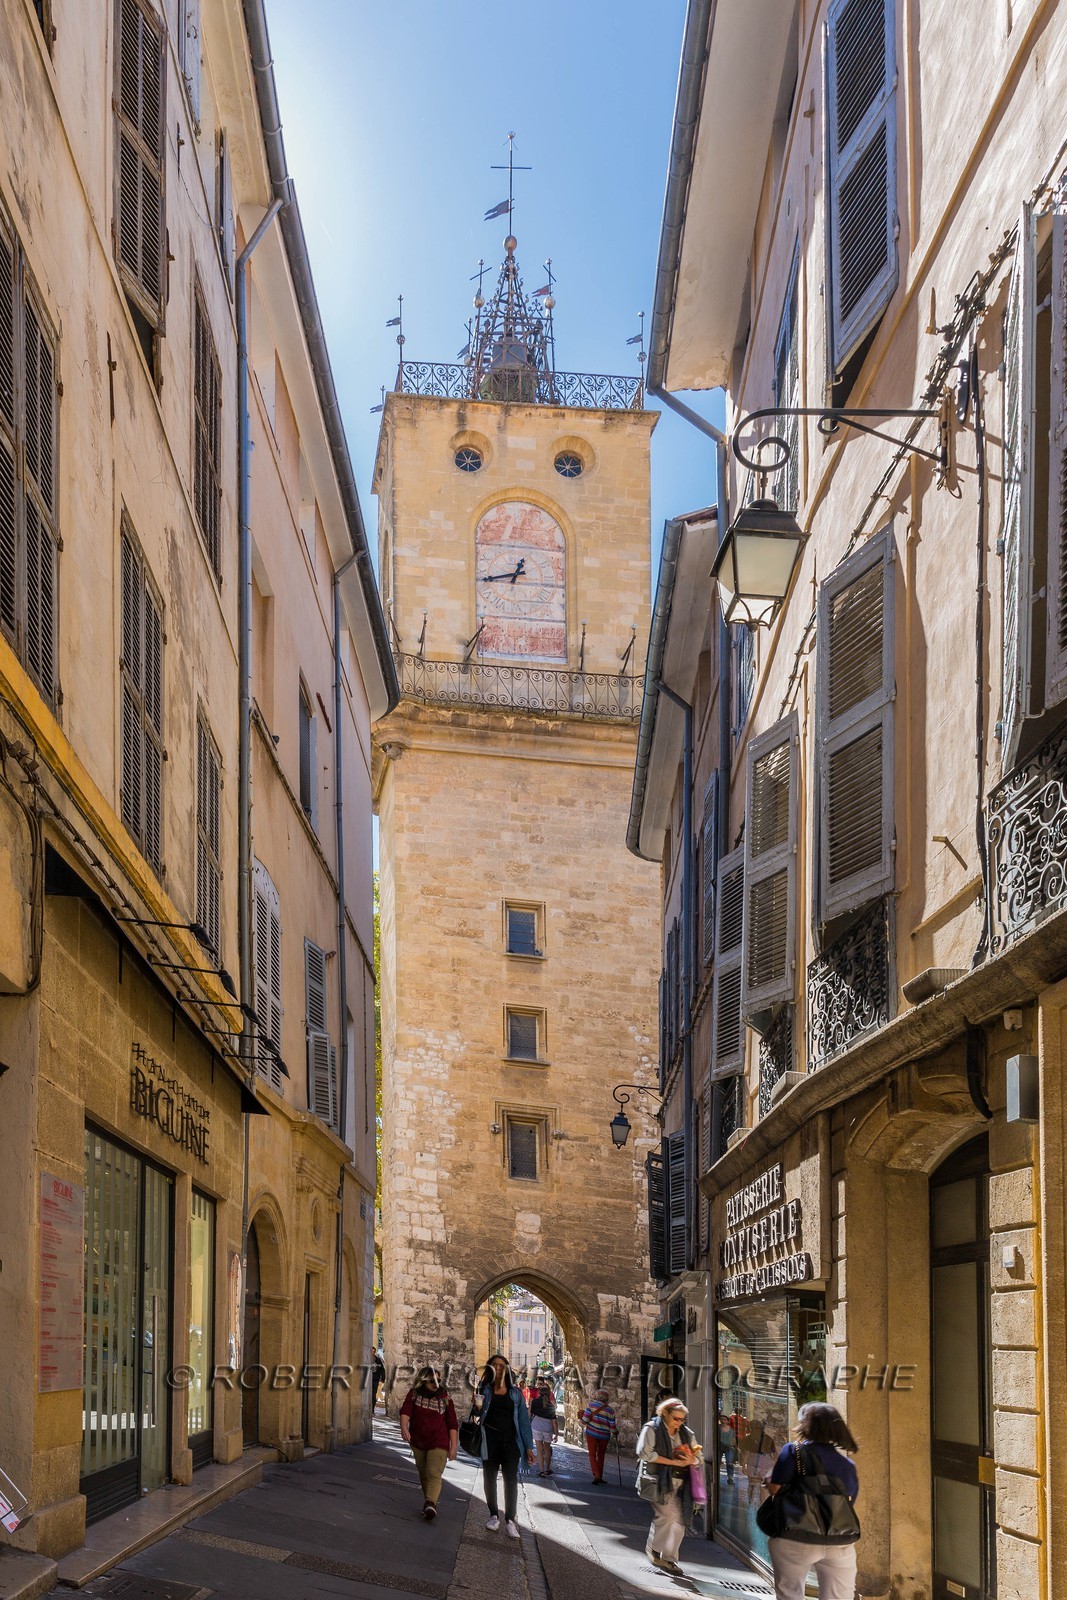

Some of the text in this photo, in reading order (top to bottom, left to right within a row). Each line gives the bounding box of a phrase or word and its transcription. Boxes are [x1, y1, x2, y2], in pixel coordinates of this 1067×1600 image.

[131, 1066, 210, 1166] BIGUINE
[726, 1162, 783, 1230] PATISSERIE
[755, 1253, 808, 1291] CALISSONS
